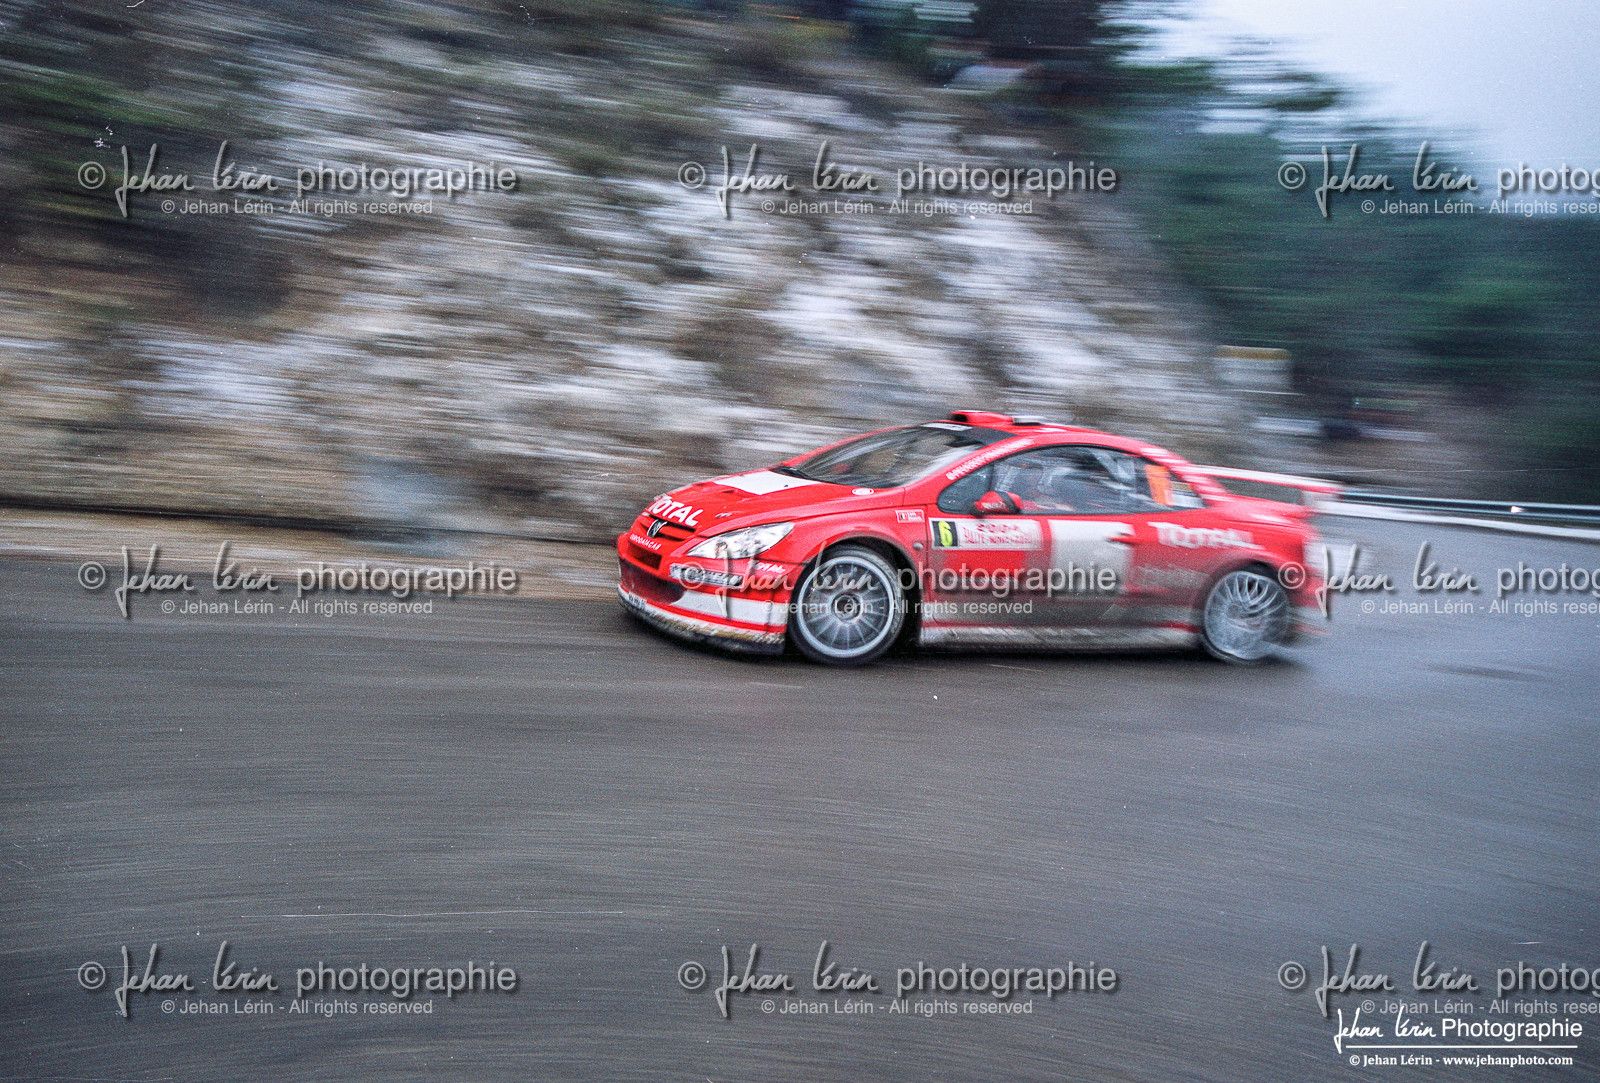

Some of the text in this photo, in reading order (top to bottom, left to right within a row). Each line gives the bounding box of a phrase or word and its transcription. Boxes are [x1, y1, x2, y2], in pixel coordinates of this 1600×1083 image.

[647, 493, 704, 527] TOTAL
[938, 521, 953, 547] 6
[1147, 521, 1267, 550] TOTAL
